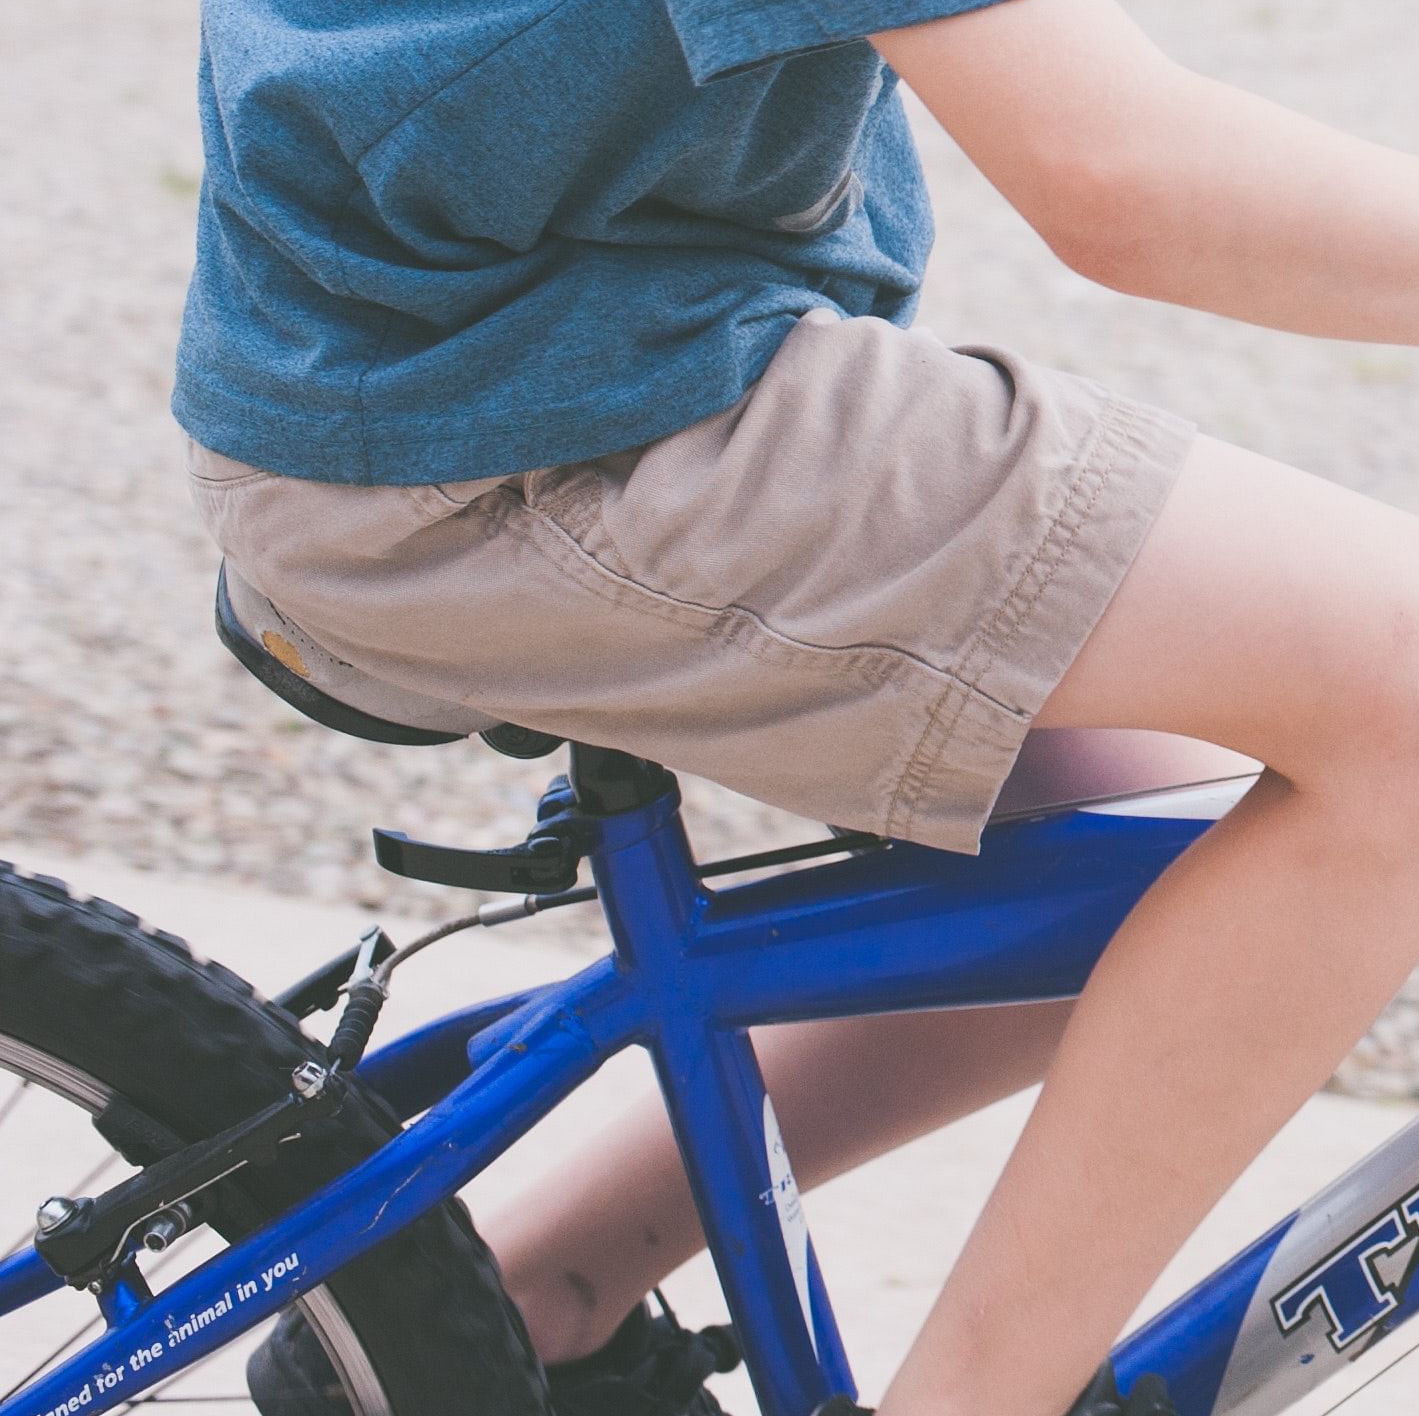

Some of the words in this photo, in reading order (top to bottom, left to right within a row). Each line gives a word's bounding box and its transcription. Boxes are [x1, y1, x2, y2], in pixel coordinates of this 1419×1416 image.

[130, 1341, 163, 1372] the
[168, 1293, 233, 1347] animal
[237, 1276, 258, 1302] in
[260, 1252, 299, 1290] you
